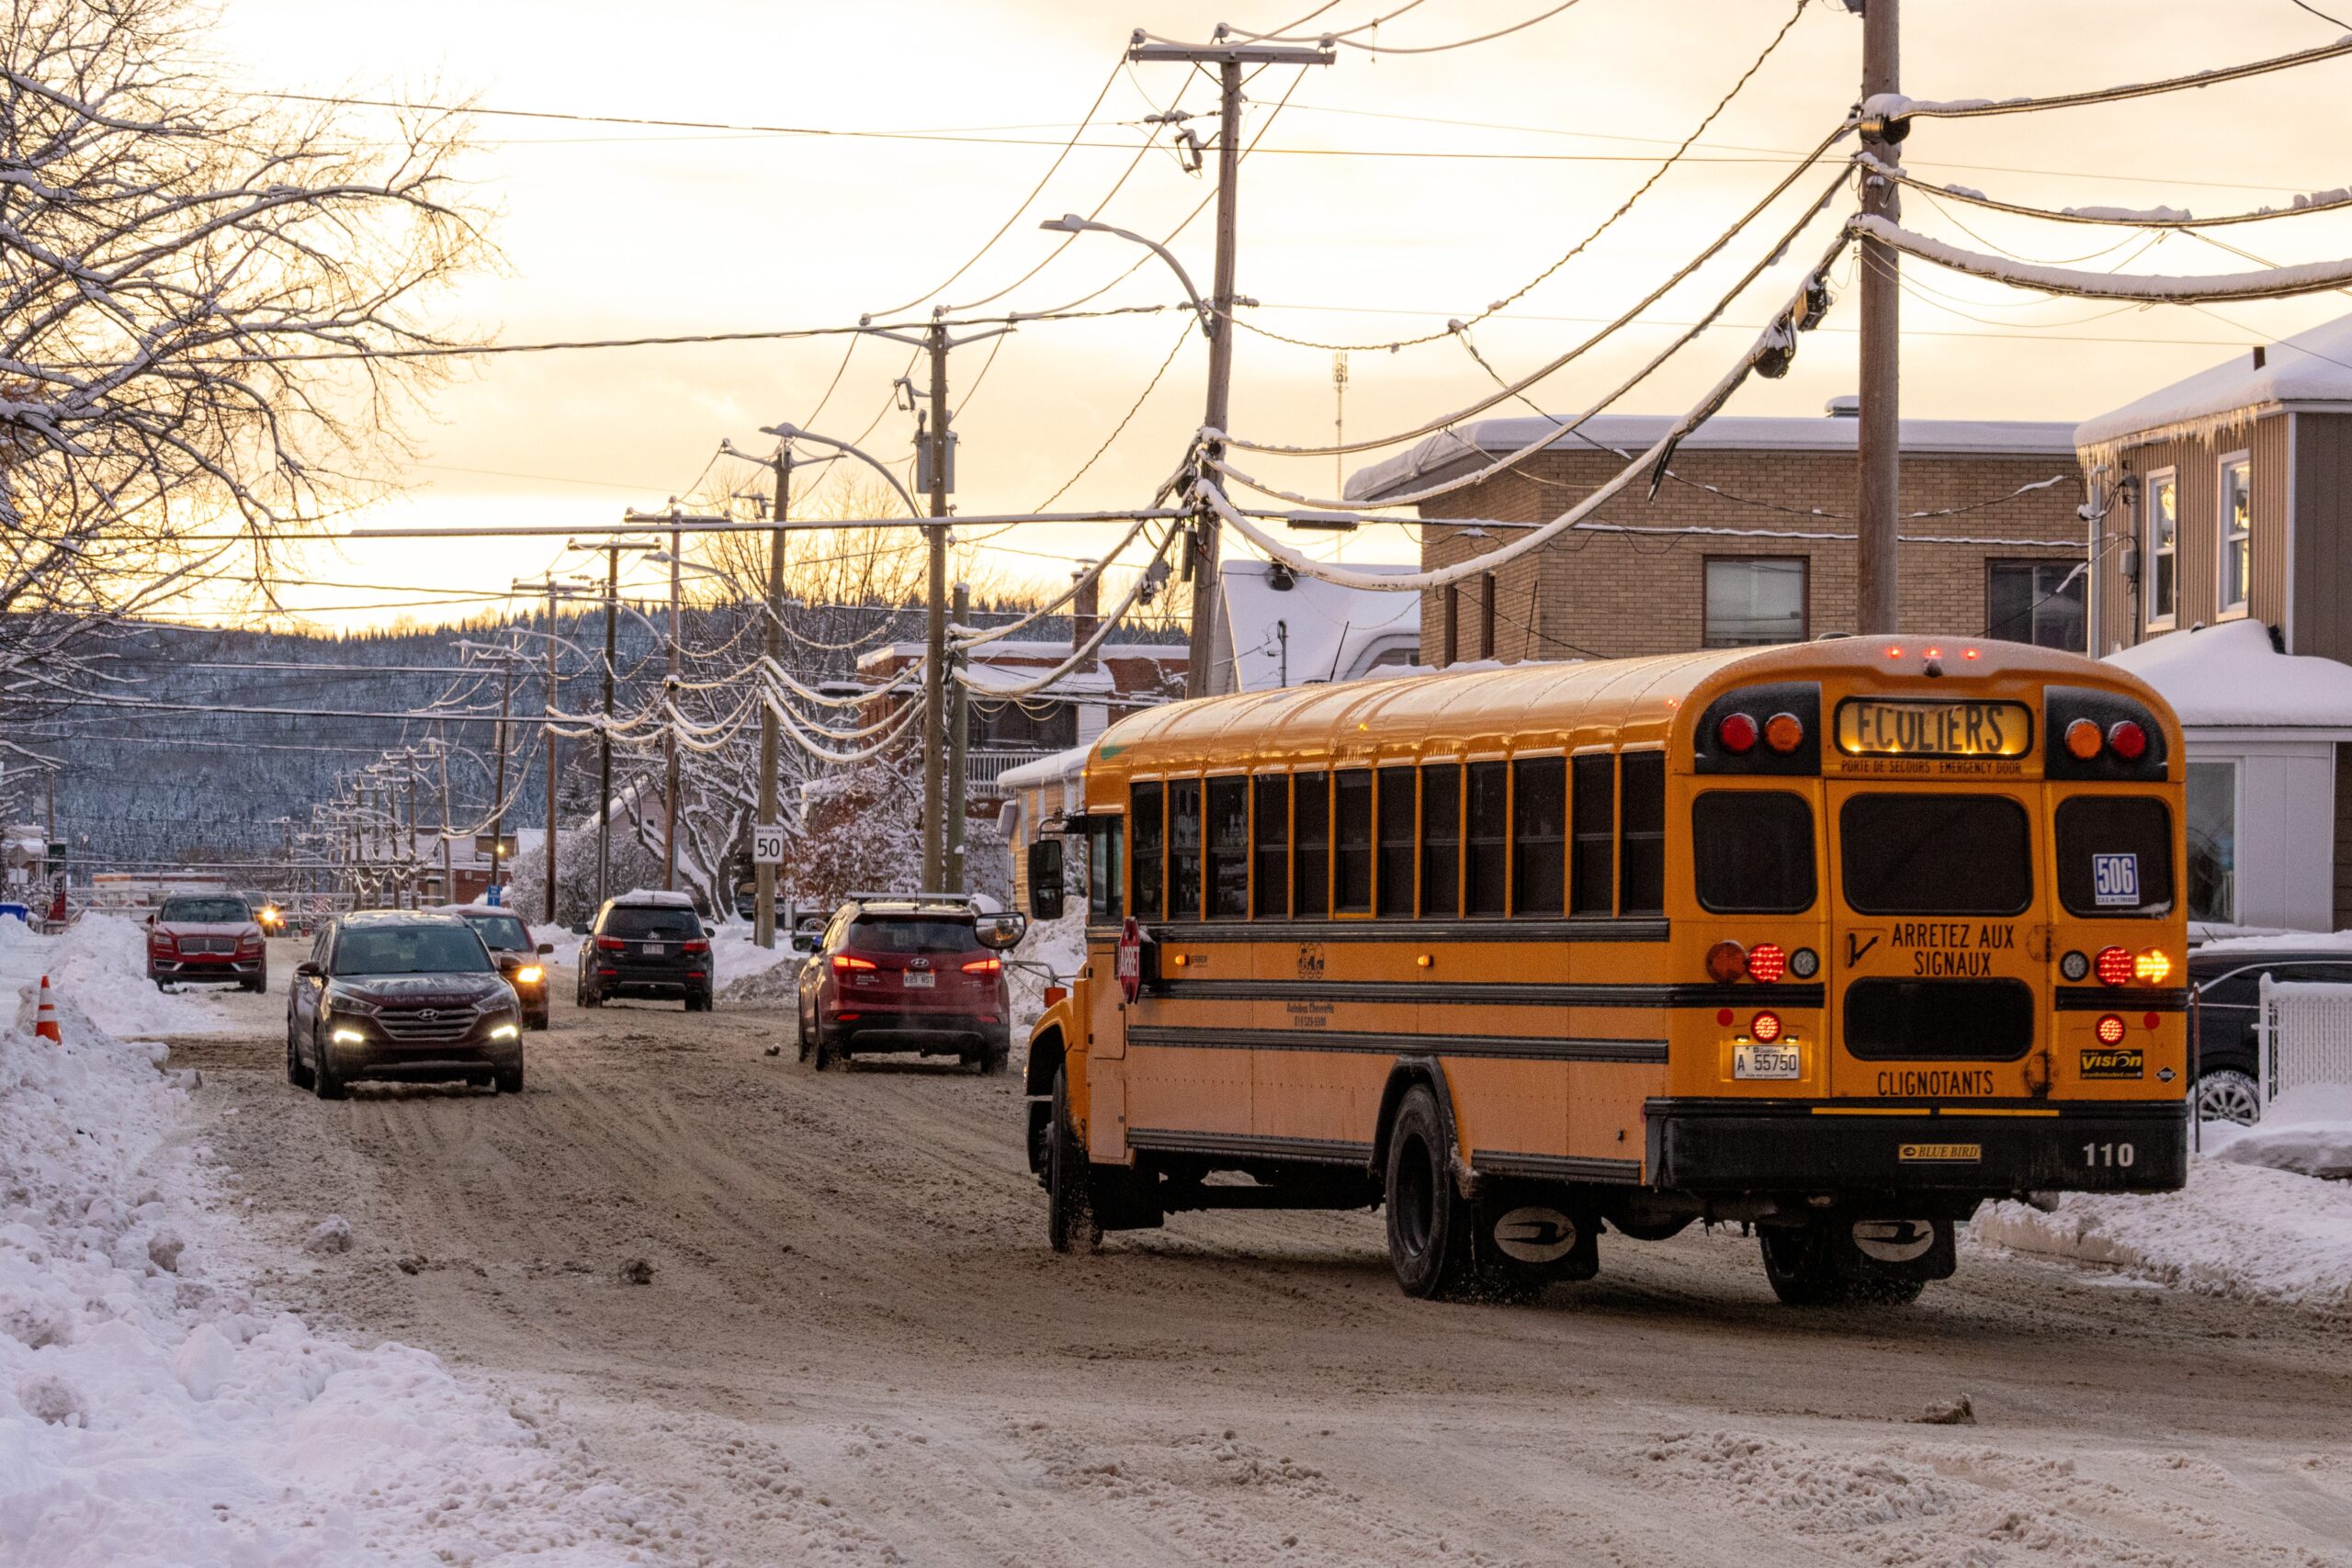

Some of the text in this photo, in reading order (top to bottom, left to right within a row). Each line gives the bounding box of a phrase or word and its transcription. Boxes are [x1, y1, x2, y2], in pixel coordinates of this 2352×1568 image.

[1841, 761, 2021, 774] PORTE DE SECOURS EMERGENCY DOOR
[758, 838, 780, 857] 50
[2097, 857, 2134, 894] 506
[1892, 923, 2014, 949] ARRETEZ AUX
[1914, 951, 1992, 976] SIGNAUX
[1736, 1055, 1797, 1071] A 55750
[1877, 1070, 1994, 1096] CLIGNOTANTS
[1918, 1146, 1978, 1157] BLUE BIRD
[2083, 1143, 2134, 1167] 110
